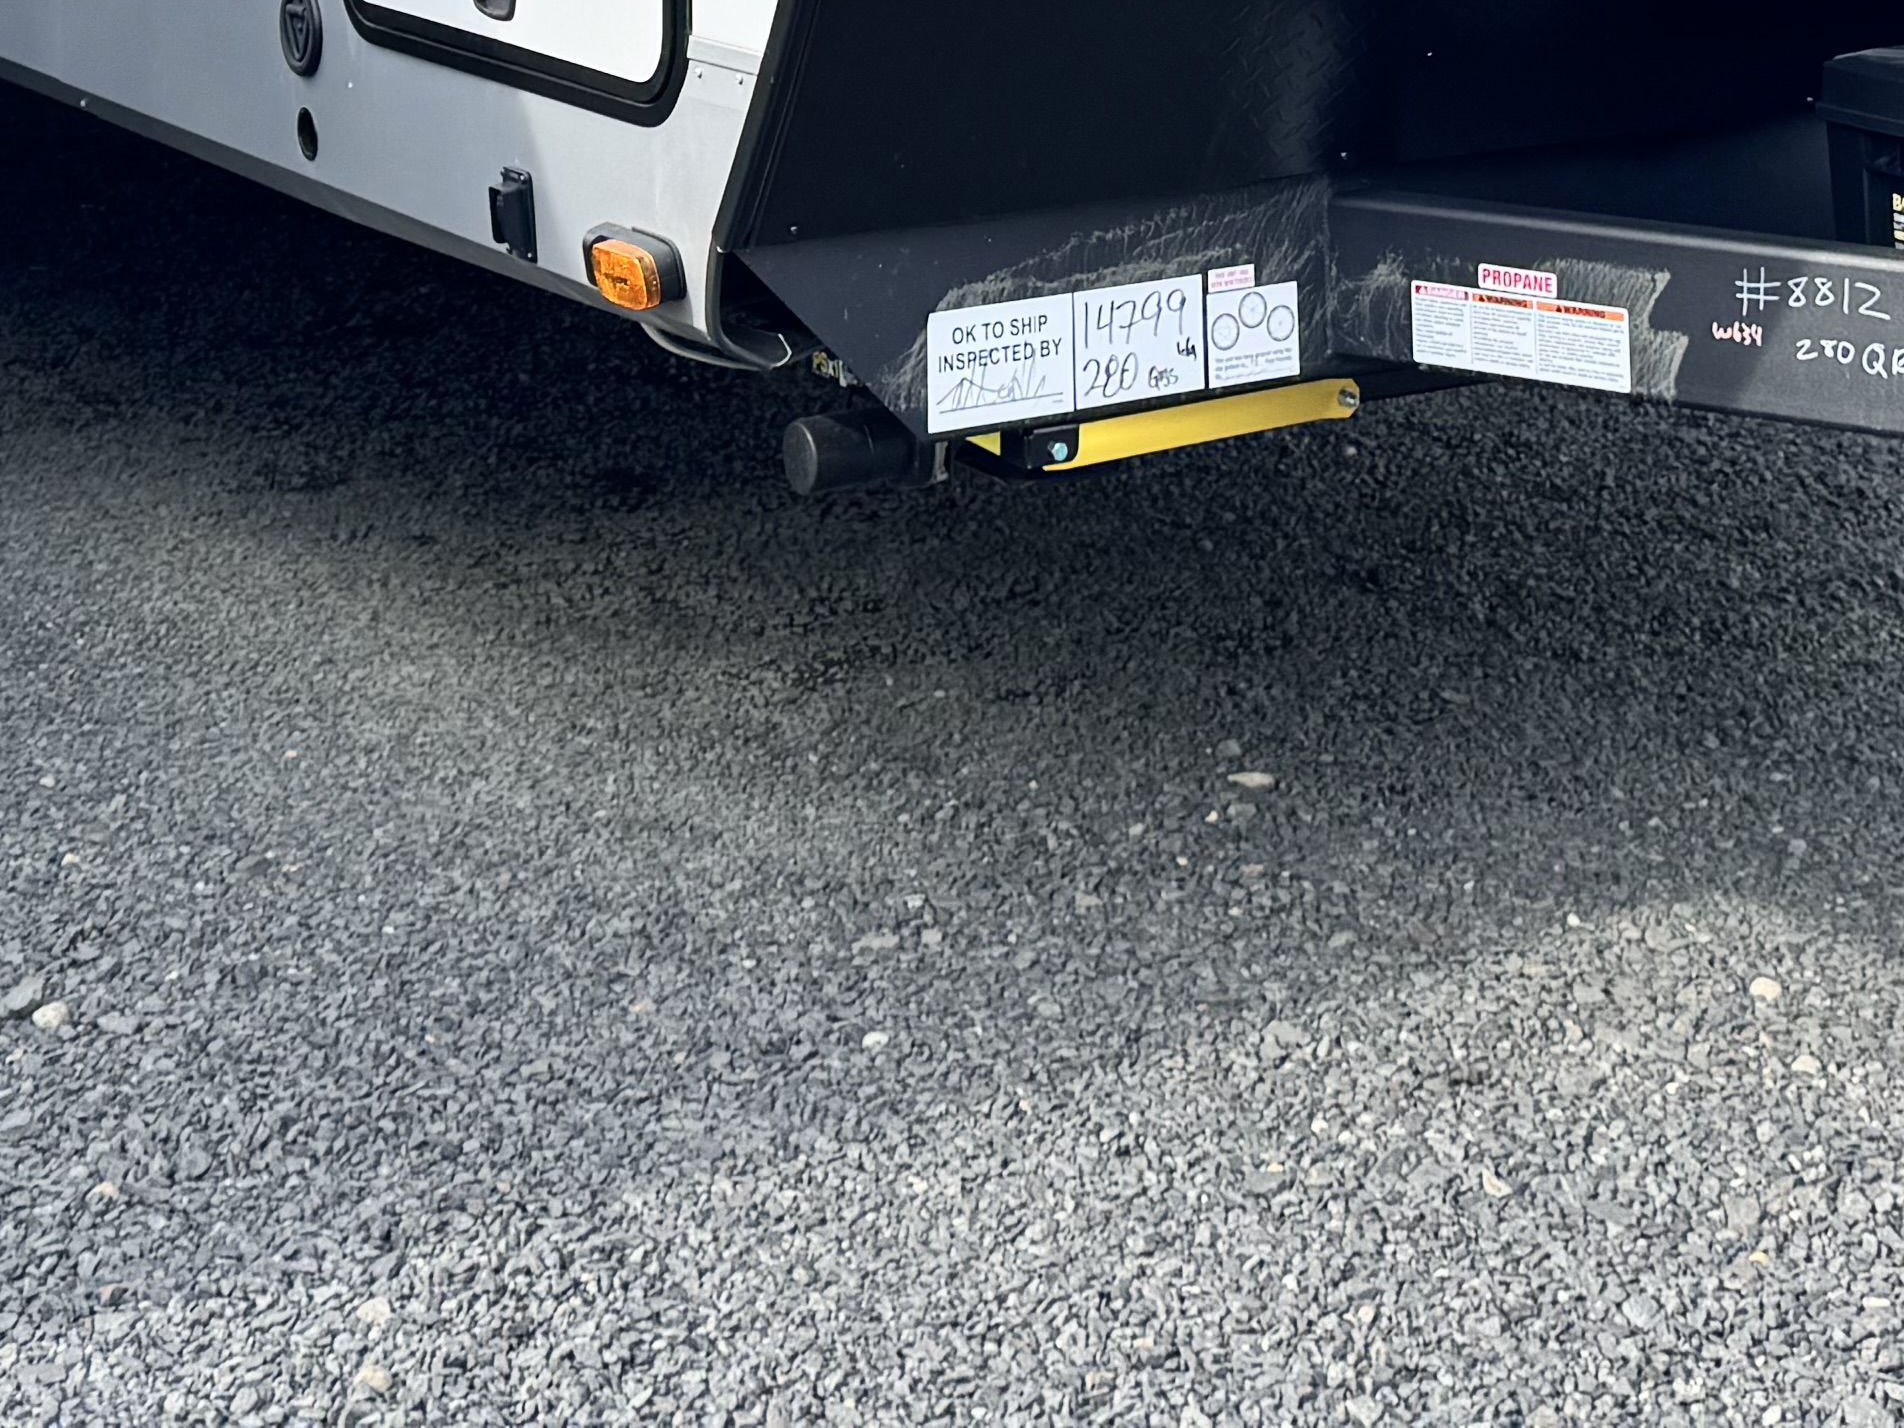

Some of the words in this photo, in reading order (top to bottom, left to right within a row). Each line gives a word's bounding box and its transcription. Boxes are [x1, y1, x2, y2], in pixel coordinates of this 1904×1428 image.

[1481, 267, 1554, 294] PROPANE
[951, 327, 975, 345] OK
[981, 322, 1005, 342] TO
[1010, 315, 1048, 337] SHIP
[1084, 289, 1188, 349] 14799
[938, 343, 1035, 373] INSPECTED
[1038, 337, 1063, 359] BY
